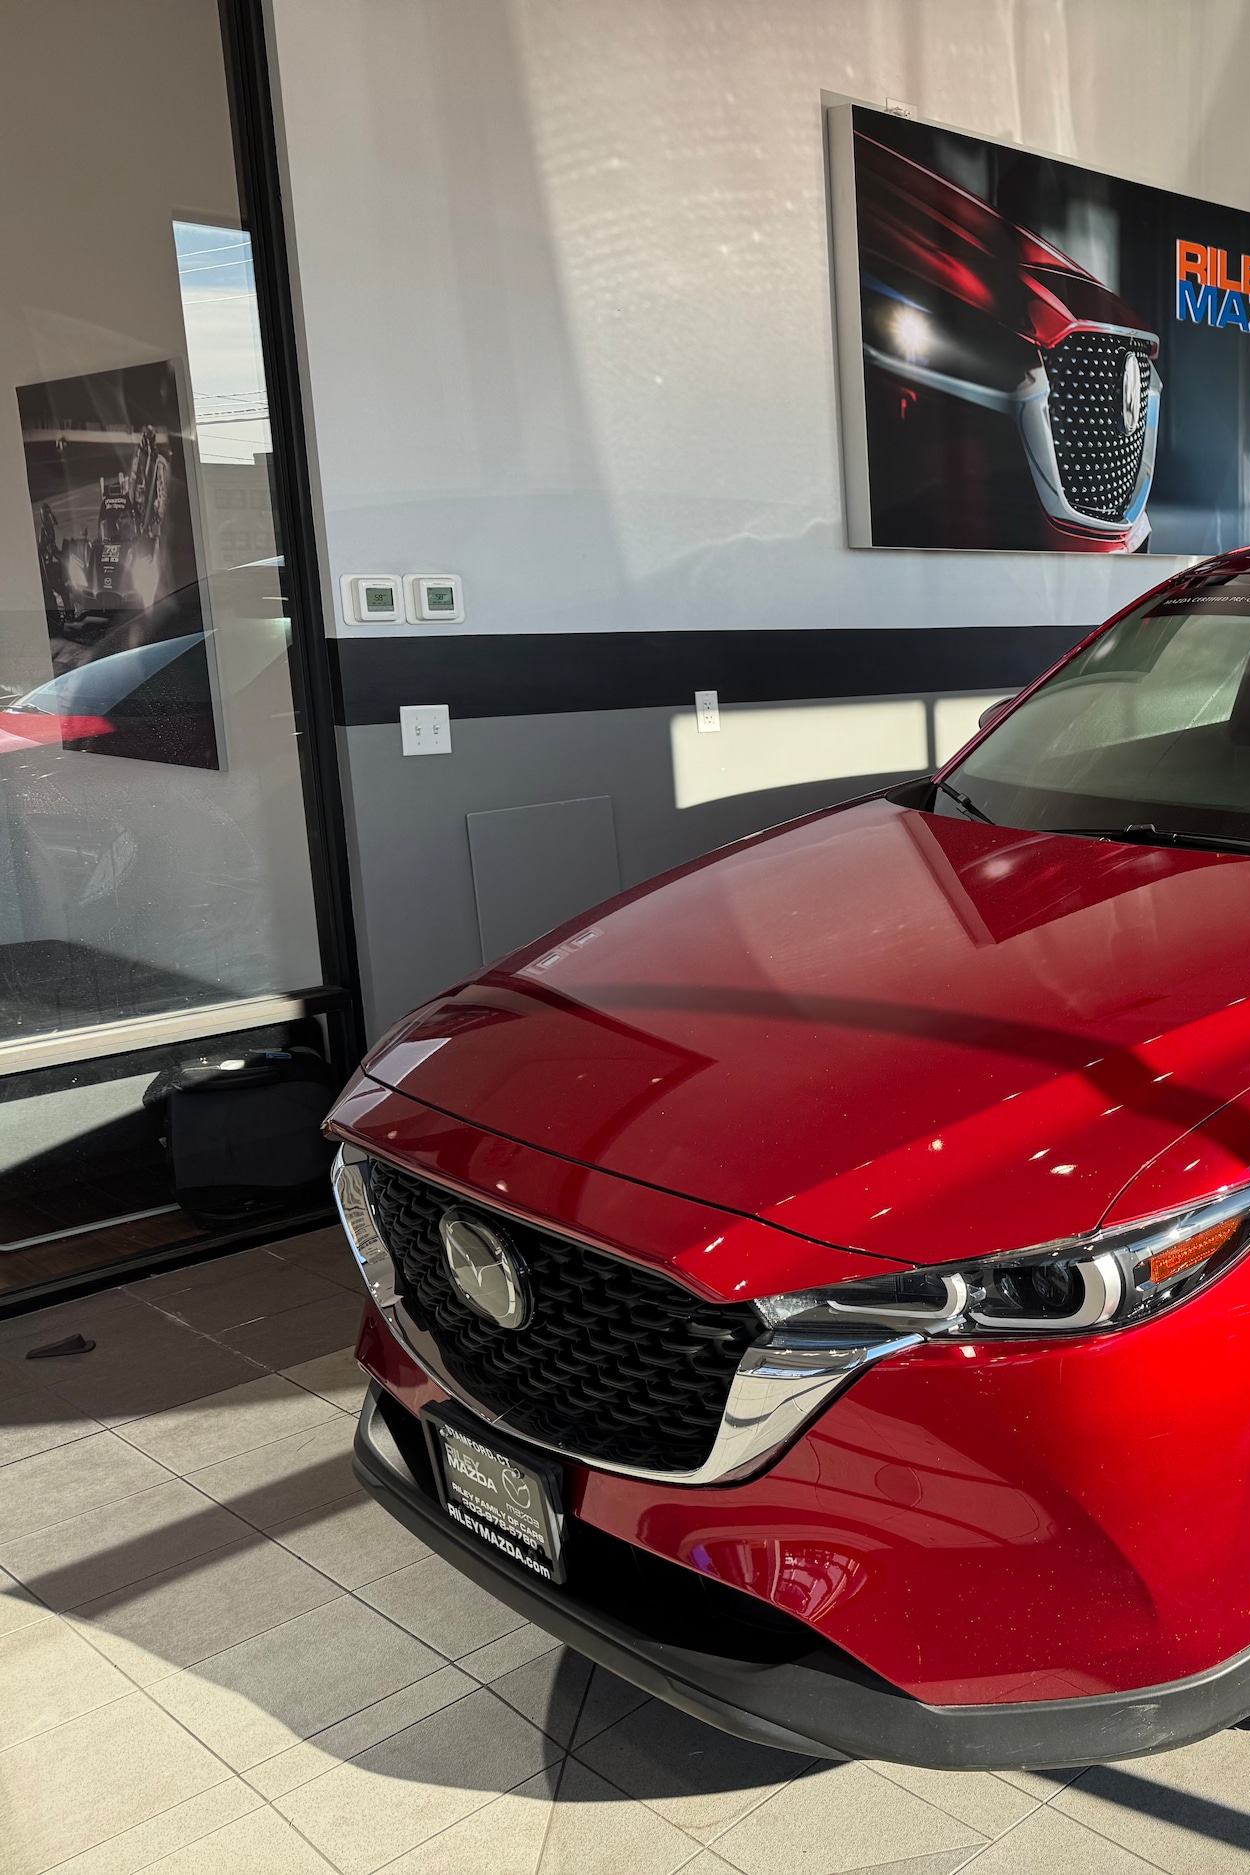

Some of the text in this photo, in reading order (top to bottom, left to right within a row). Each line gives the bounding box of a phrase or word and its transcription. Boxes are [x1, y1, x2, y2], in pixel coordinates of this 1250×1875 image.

[445, 1443, 480, 1472] RILEY
[447, 1453, 498, 1493] MAZDA
[451, 1482, 545, 1544] RILEY FAMILY OF CARS
[447, 1503, 551, 1580] RILEYMAZDA.com
